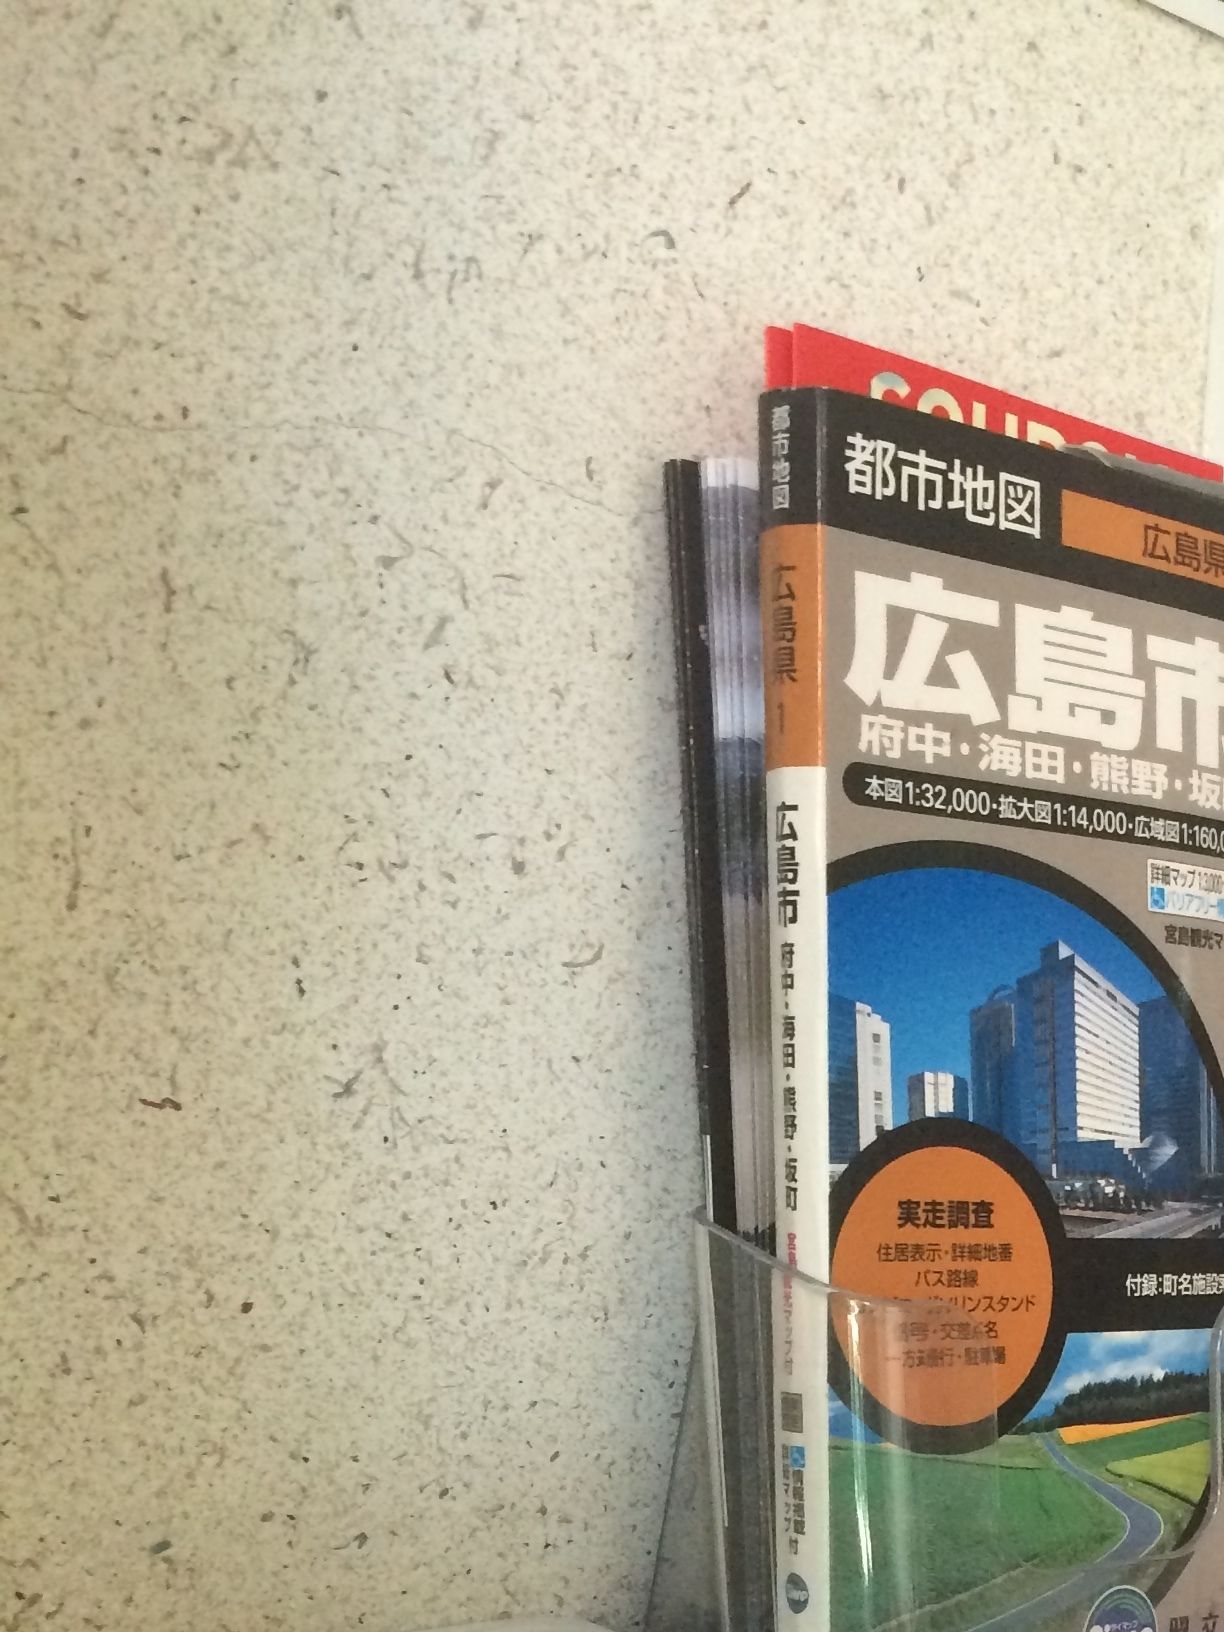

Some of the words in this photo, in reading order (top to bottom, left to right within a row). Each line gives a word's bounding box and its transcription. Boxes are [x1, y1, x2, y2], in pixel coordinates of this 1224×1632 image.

[843, 432, 1042, 540] 都市地図
[774, 800, 801, 929] 広島市
[897, 1198, 995, 1230] 実走調査
[877, 1243, 1013, 1263] 住居表示・詳細地番
[915, 1269, 979, 1289] バス路線
